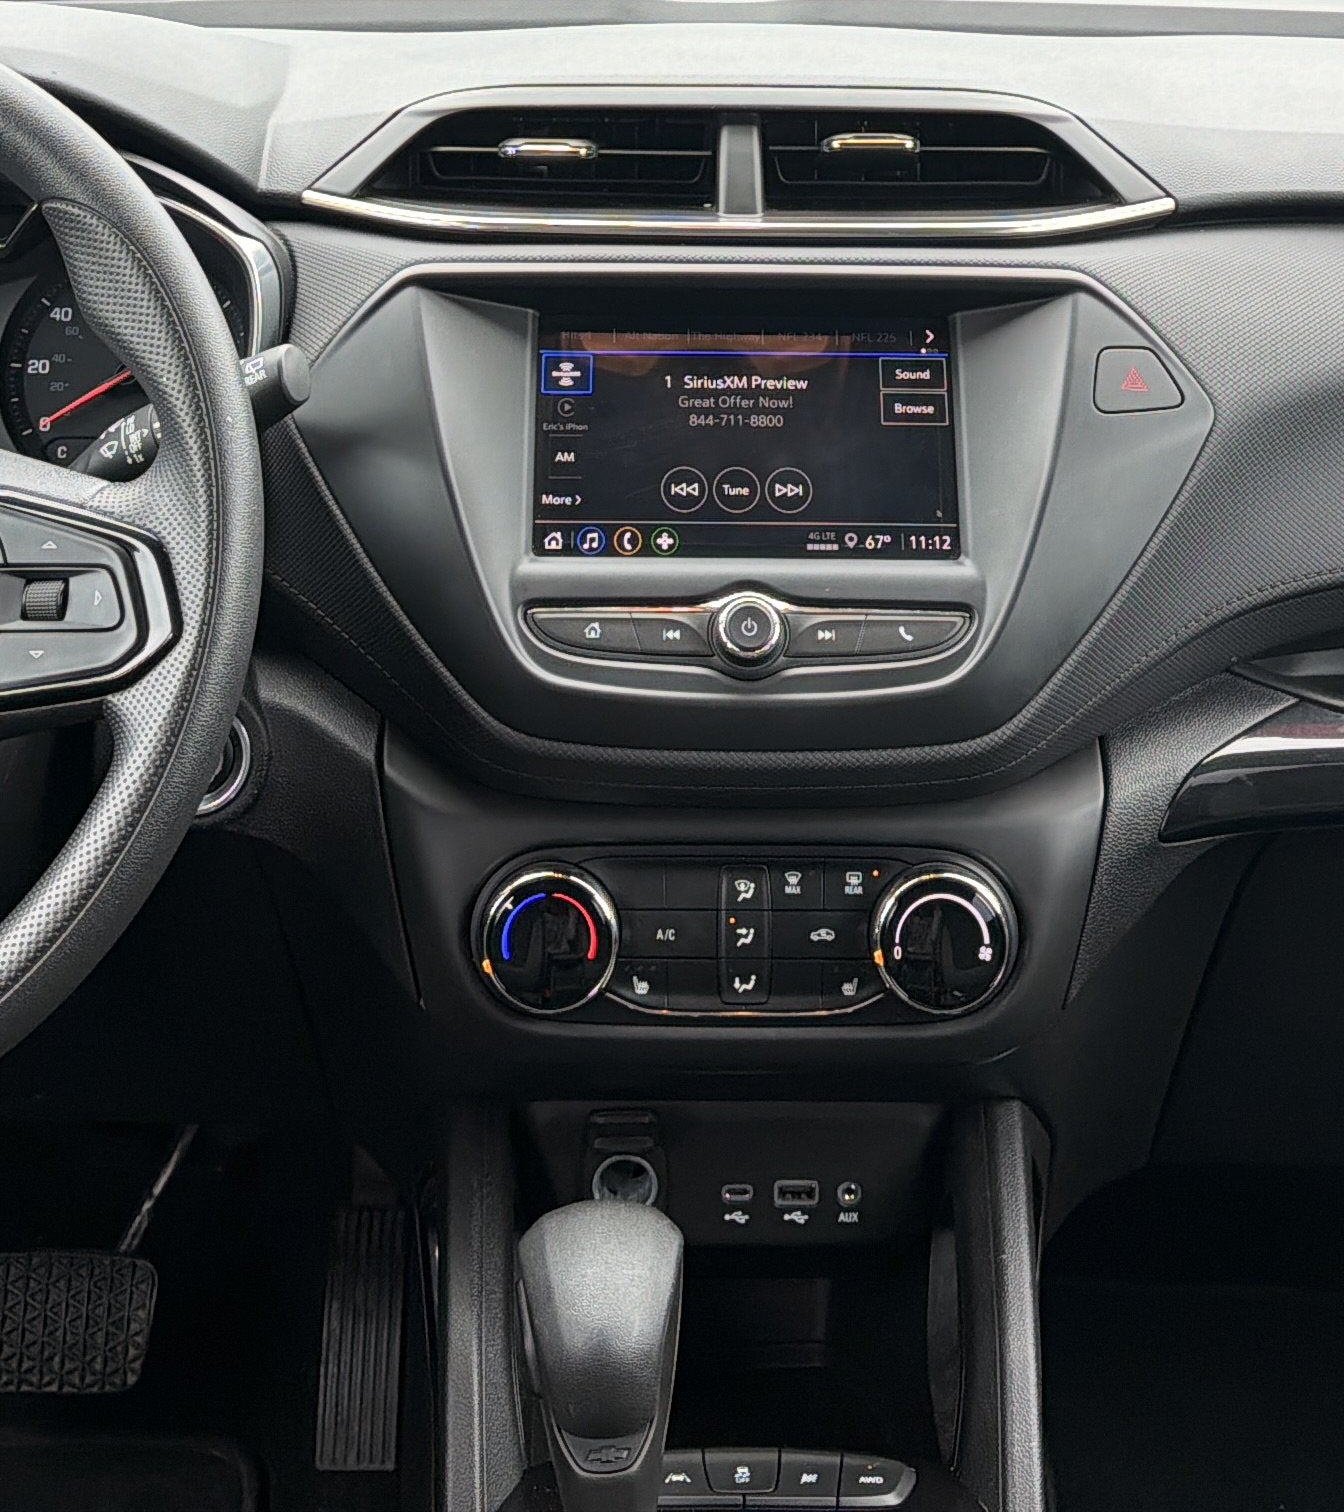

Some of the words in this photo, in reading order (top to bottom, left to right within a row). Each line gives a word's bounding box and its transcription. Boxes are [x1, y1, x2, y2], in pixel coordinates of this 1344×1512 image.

[50, 307, 73, 322] 40
[65, 326, 79, 336] 60
[852, 332, 874, 343] NFL
[27, 359, 50, 374] 20
[895, 369, 930, 382] Sound
[664, 375, 672, 389] 1
[684, 375, 748, 389] SiriusXM
[751, 375, 808, 390] Preview
[678, 395, 715, 408] Great
[718, 395, 755, 408] Offer
[758, 396, 793, 409] Now!
[894, 402, 935, 415] Browse
[689, 414, 784, 427] 844-711-8800
[555, 451, 575, 463] AM
[722, 484, 750, 496] Tune
[542, 494, 572, 505] More
[822, 532, 836, 541] LTE
[910, 535, 952, 551] 11:12
[784, 885, 801, 895] MAX
[844, 885, 863, 895] REAR
[656, 928, 676, 941] A/C
[837, 1212, 859, 1223] AUX
[858, 1475, 884, 1485] AWD
